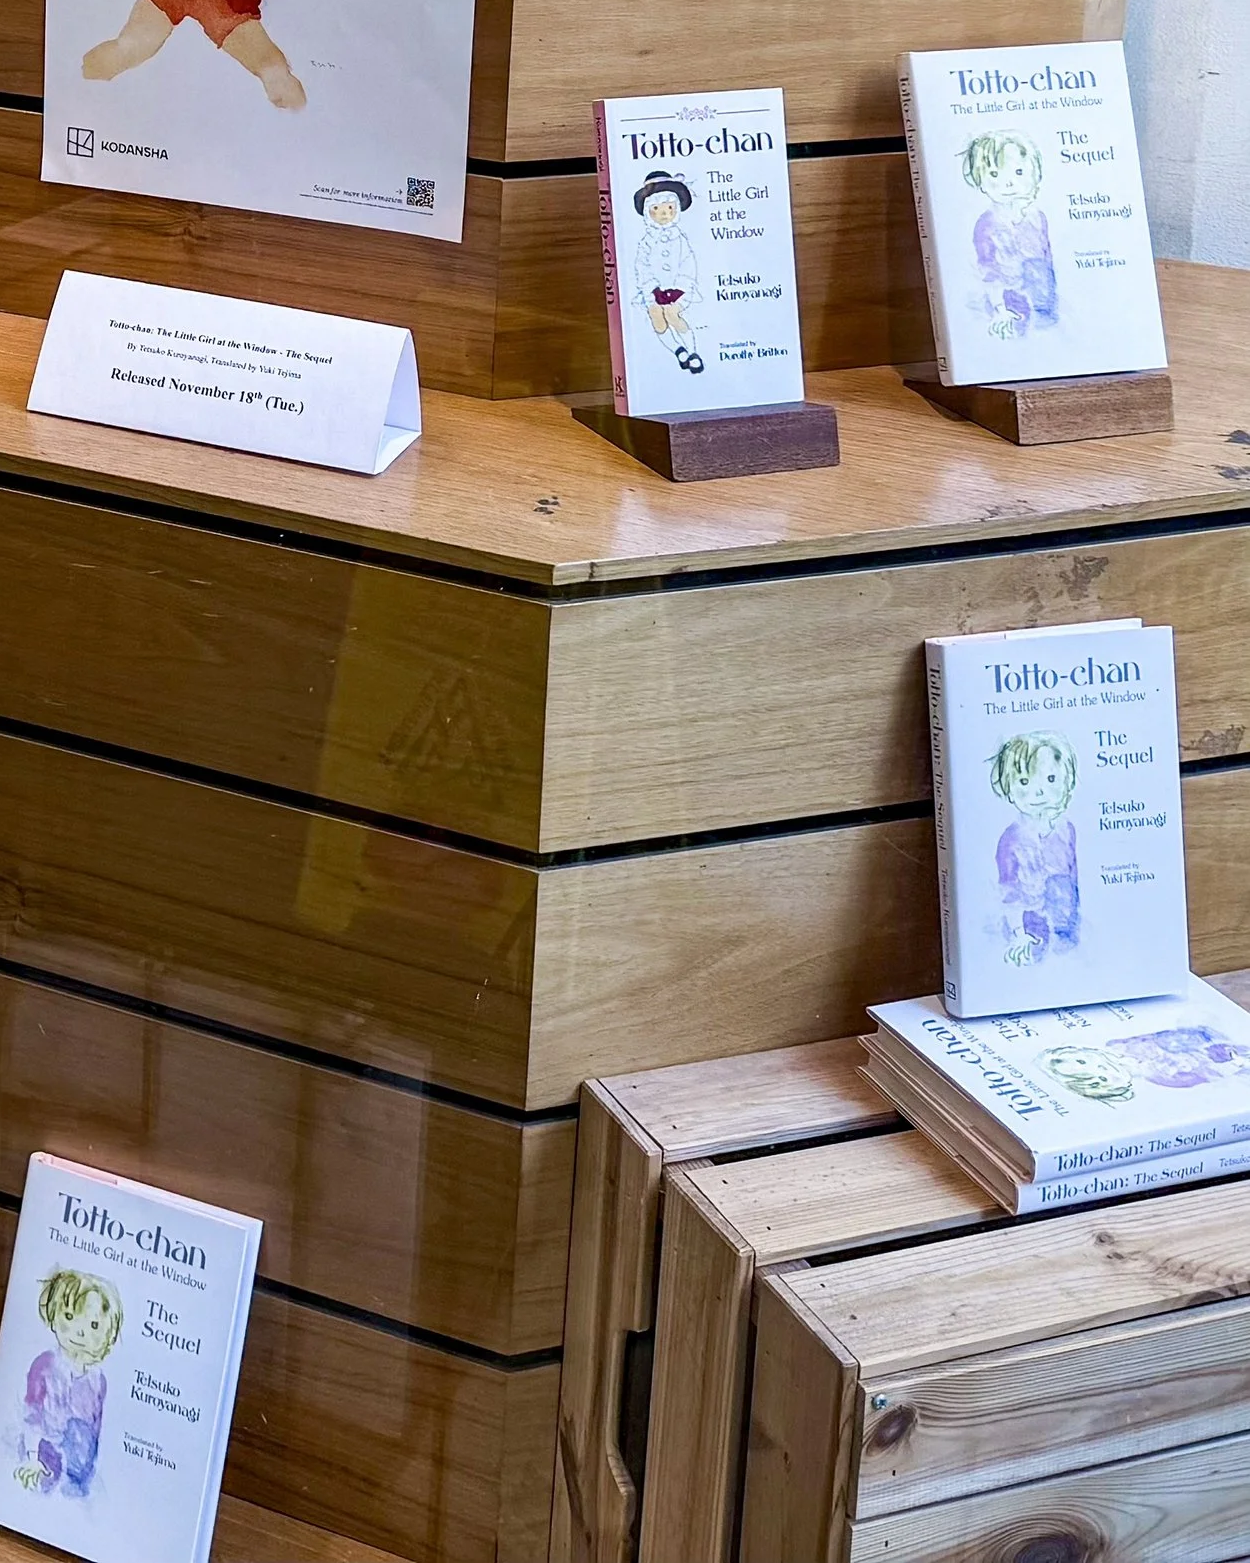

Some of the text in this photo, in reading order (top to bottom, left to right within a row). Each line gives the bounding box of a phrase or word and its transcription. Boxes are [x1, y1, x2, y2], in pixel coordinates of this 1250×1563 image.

[949, 66, 1097, 96] Totto-chan
[101, 140, 169, 160] KODANSHA
[622, 128, 773, 160] Totto-chan
[1056, 130, 1089, 145] The
[1060, 146, 1115, 166] Sequel
[707, 171, 733, 184] The
[708, 186, 770, 203] Little Girl
[710, 208, 747, 222] at the
[711, 227, 765, 240] Window
[714, 272, 761, 287] Tetsuko
[157, 327, 172, 337] The
[174, 330, 197, 342] Little
[198, 334, 216, 345] Girl
[217, 339, 226, 347] at
[227, 340, 241, 350] the
[243, 341, 277, 355] Window
[286, 349, 302, 359] The
[304, 352, 333, 365] Sequel
[110, 367, 166, 389] Released
[169, 378, 235, 402] November
[265, 395, 305, 415] (Tue.)
[984, 657, 1141, 693] Totto-chan
[983, 691, 1147, 715] The Little Girl at the Window
[1094, 730, 1128, 747] The
[1096, 747, 1154, 769] Sequel
[922, 1019, 1045, 1122] Totto-chan
[1054, 1128, 1217, 1172] Totto-chan: The Sequel
[1037, 1177, 1129, 1203] Totto-chan:
[1134, 1173, 1158, 1186] The
[1160, 1162, 1204, 1181] Sequel
[58, 1192, 207, 1270] Totto-chan
[49, 1227, 207, 1292] The Little Girl at the Window
[146, 1299, 179, 1326] The
[141, 1322, 202, 1356] Sequel
[134, 1369, 181, 1399] Tetsuko
